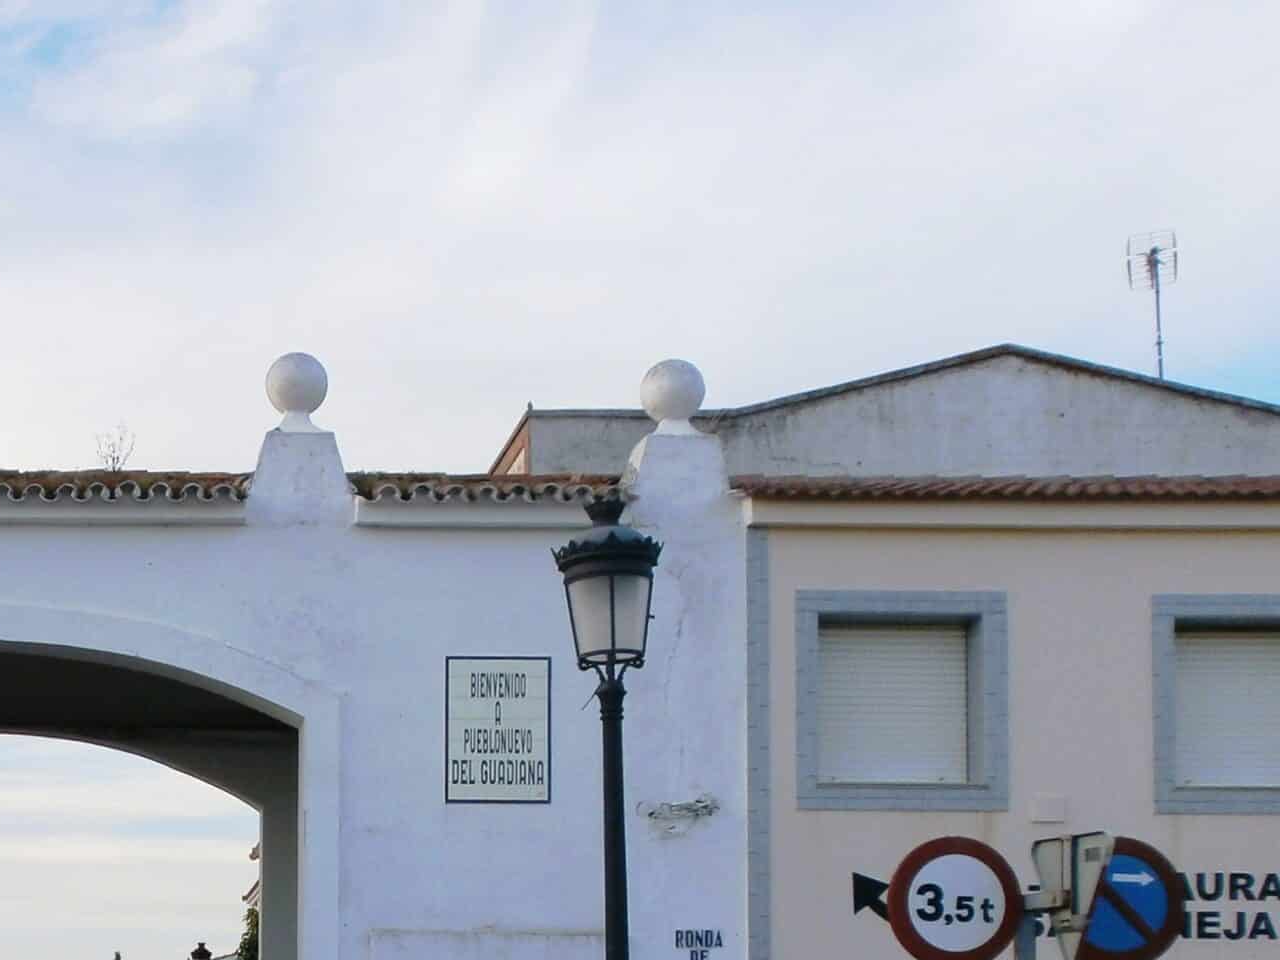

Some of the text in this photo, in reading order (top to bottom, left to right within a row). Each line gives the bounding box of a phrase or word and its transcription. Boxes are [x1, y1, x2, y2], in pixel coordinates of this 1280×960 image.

[470, 672, 527, 699] BIENVENIDO
[494, 701, 502, 726] A
[463, 729, 533, 754] PUEBLONUEVO
[451, 759, 544, 785] DEL GUADIANA
[675, 929, 723, 948] RONDA
